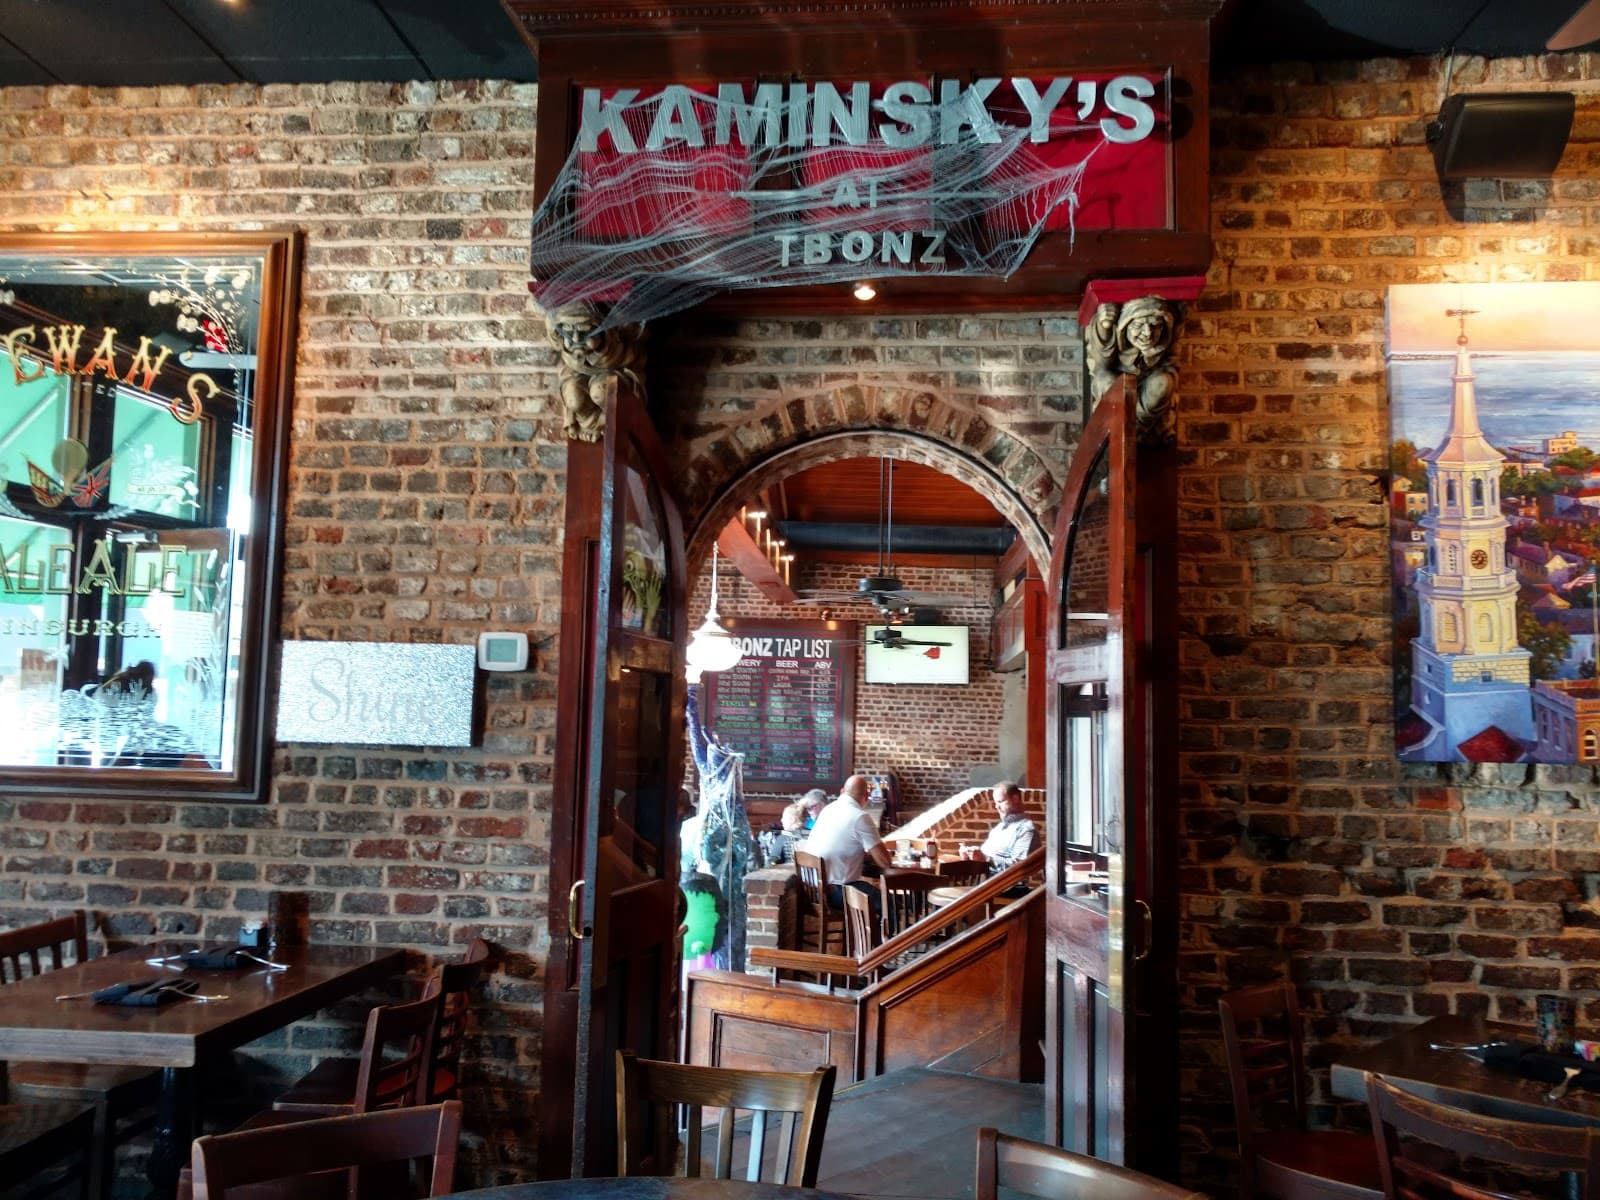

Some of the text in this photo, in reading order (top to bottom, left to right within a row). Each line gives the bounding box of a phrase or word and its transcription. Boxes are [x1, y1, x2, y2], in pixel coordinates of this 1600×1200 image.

[579, 76, 1156, 153] KAMINSKY'S
[831, 176, 881, 208] AT
[775, 229, 947, 266] TBONZ
[0, 324, 220, 424] EWAN'S
[75, 538, 188, 596] ALE
[775, 638, 802, 657] TAP
[804, 639, 832, 659] LIST
[775, 660, 799, 668] BEER
[814, 661, 832, 669] ABV
